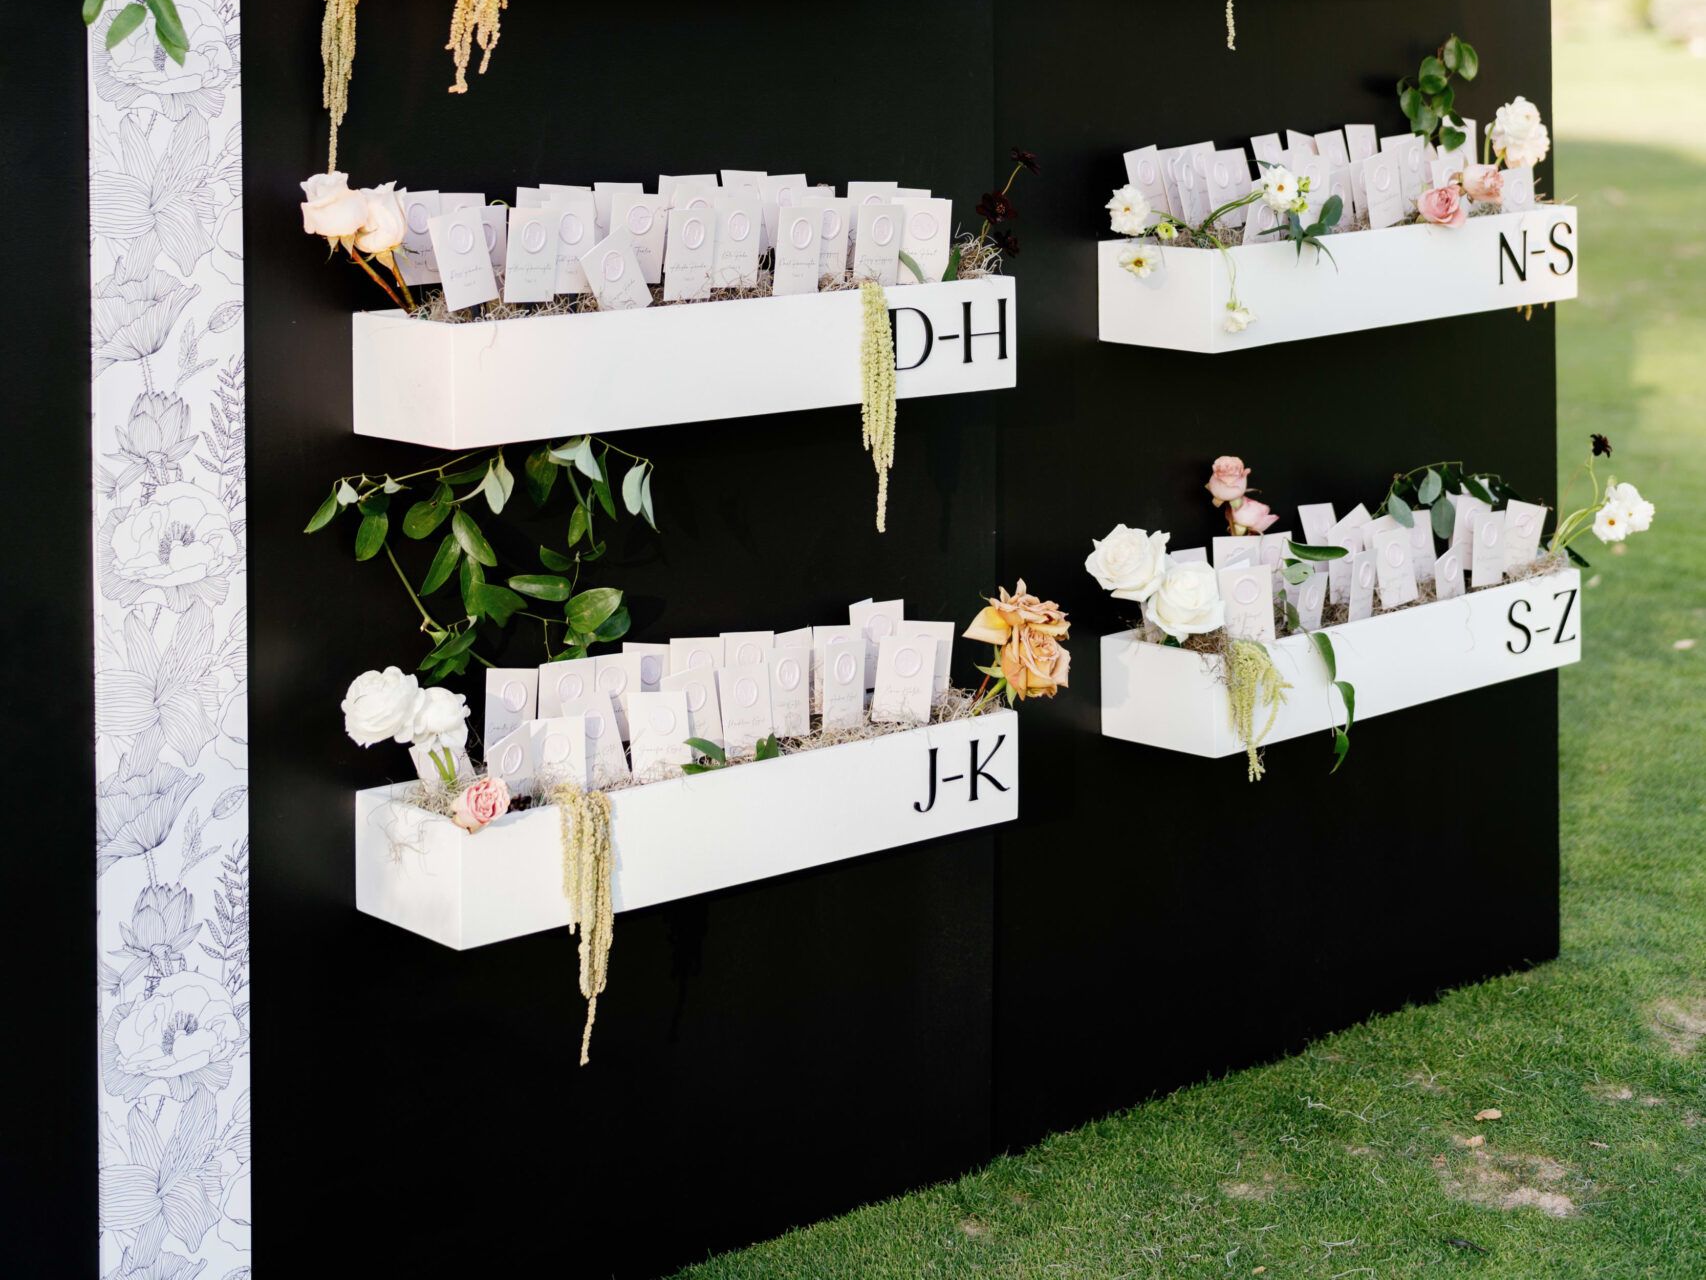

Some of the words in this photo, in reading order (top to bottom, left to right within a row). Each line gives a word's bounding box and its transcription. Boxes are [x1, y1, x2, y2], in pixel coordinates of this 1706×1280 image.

[1498, 221, 1575, 286] N-S
[887, 297, 1008, 371] D-H
[1506, 588, 1578, 655] S-Z
[913, 734, 1010, 813] J-K
